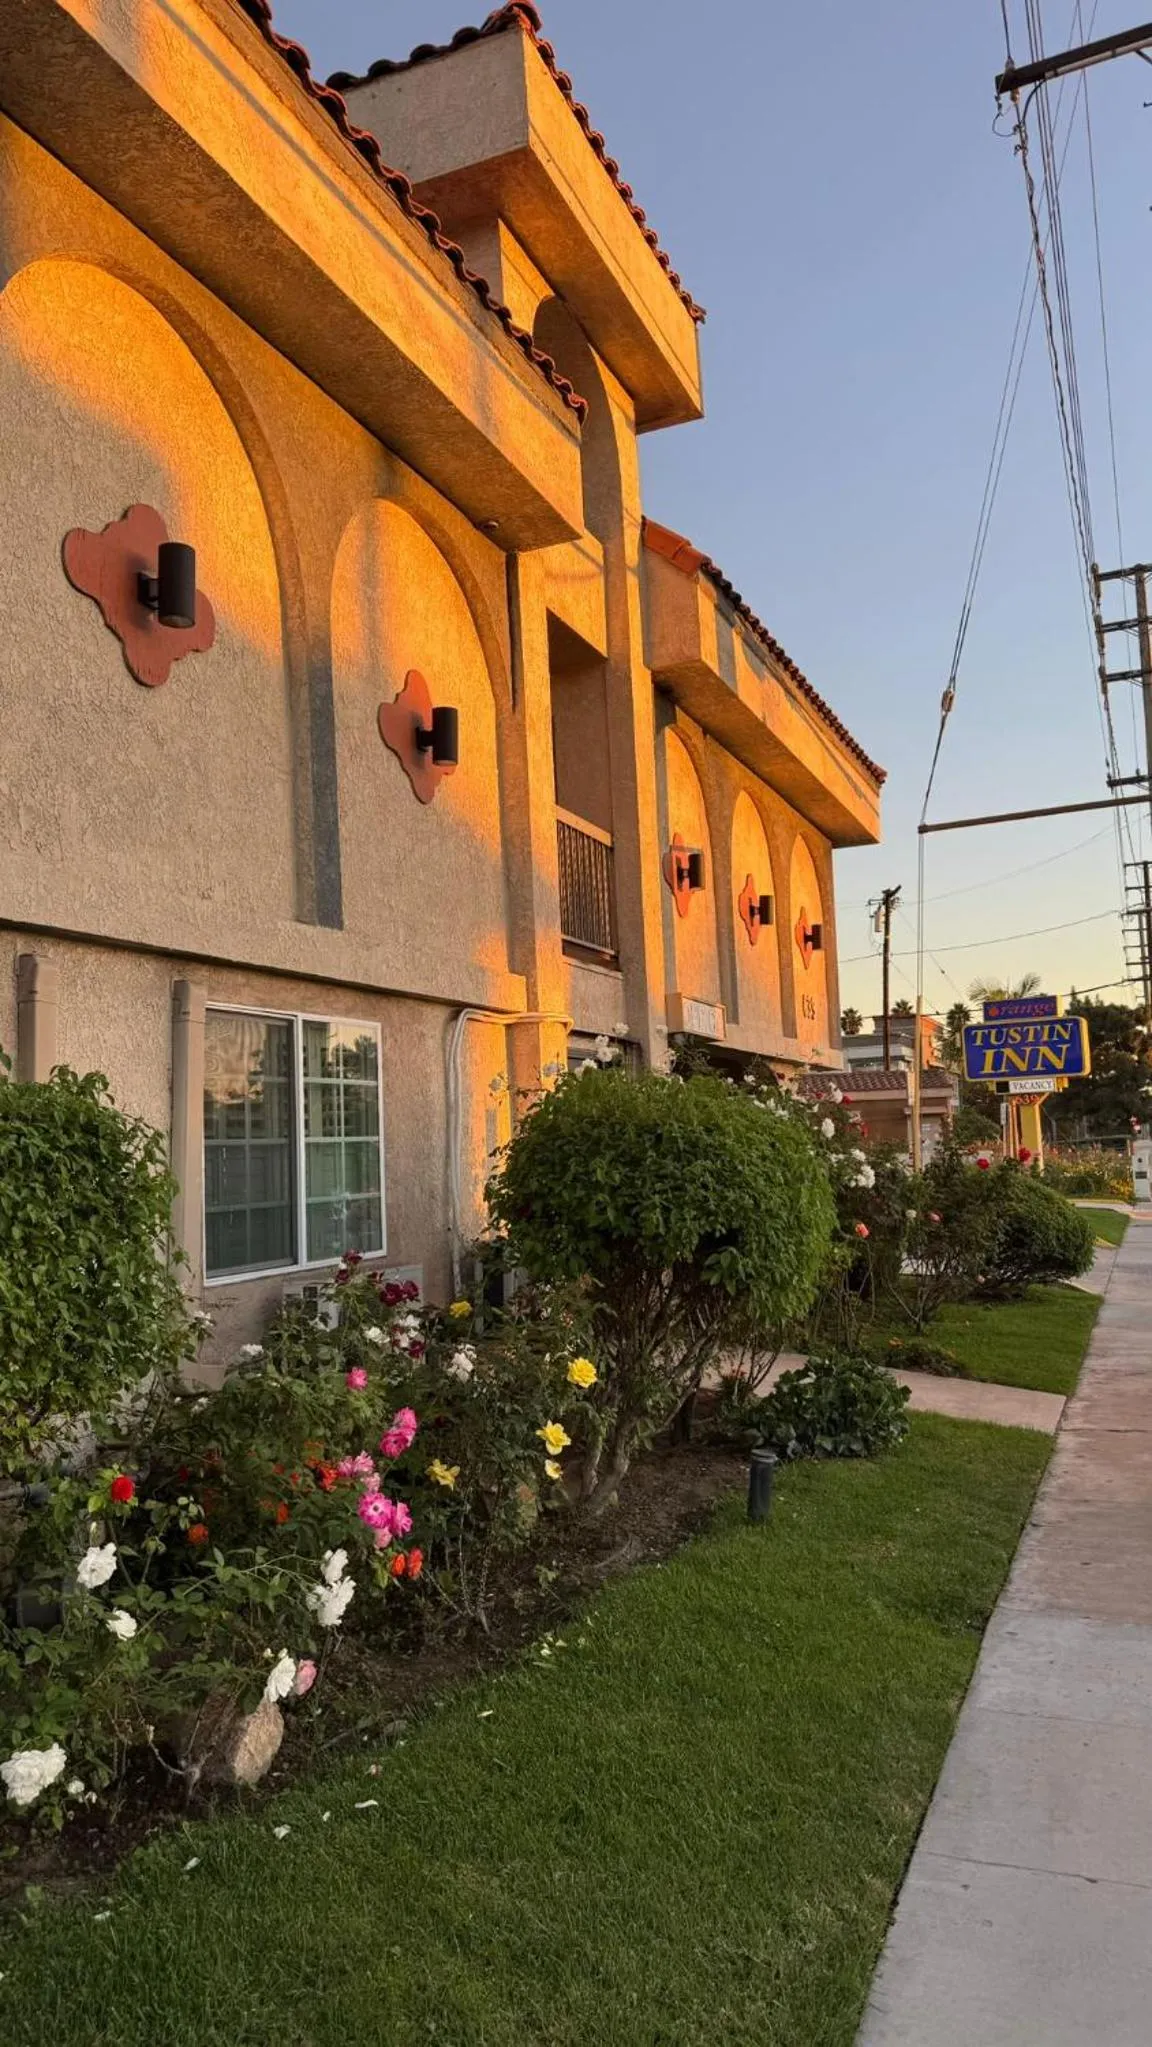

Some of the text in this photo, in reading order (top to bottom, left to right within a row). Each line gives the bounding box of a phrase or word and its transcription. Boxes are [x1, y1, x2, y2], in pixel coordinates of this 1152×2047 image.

[971, 1023, 1073, 1046] TUSTIN
[980, 1044, 1071, 1074] INN
[1013, 1081, 1052, 1090] VACANCY
